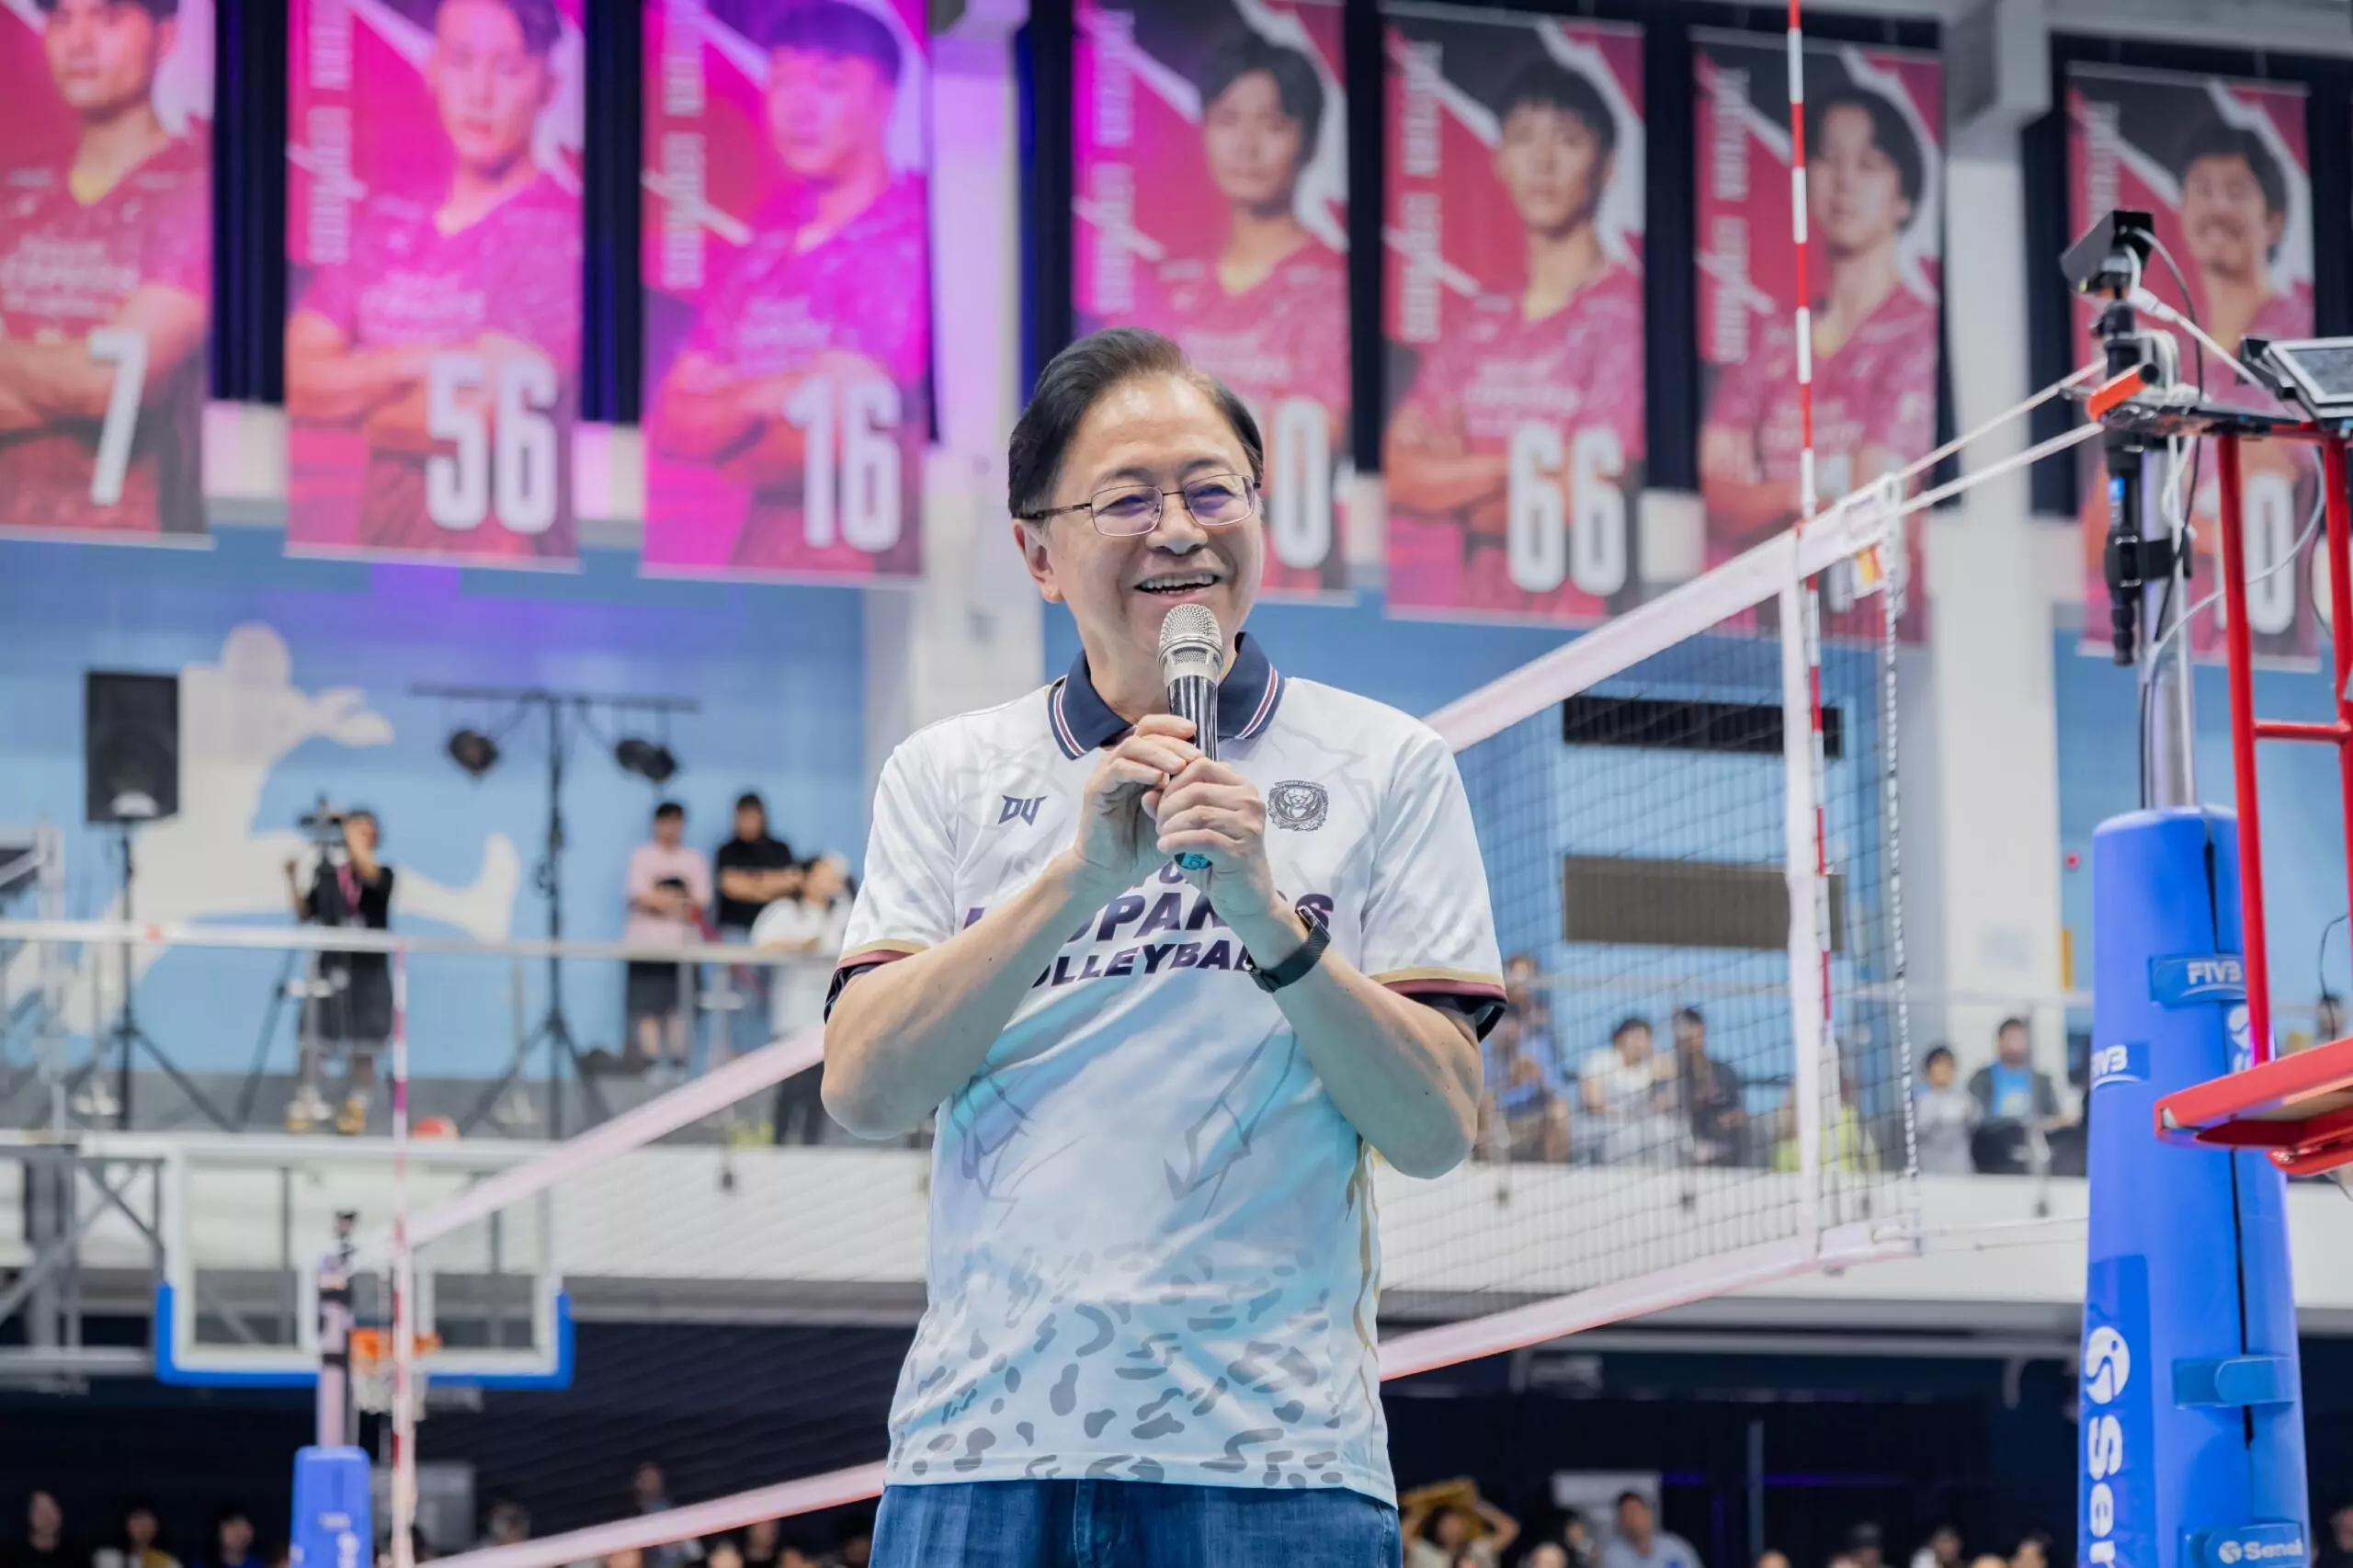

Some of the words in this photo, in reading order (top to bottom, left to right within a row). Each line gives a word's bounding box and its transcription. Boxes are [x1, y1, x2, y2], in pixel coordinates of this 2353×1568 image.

[89, 328, 147, 506] 7
[426, 353, 557, 533] 56
[784, 373, 903, 551] 16
[1261, 396, 1332, 569] 0
[1507, 421, 1626, 596] 66
